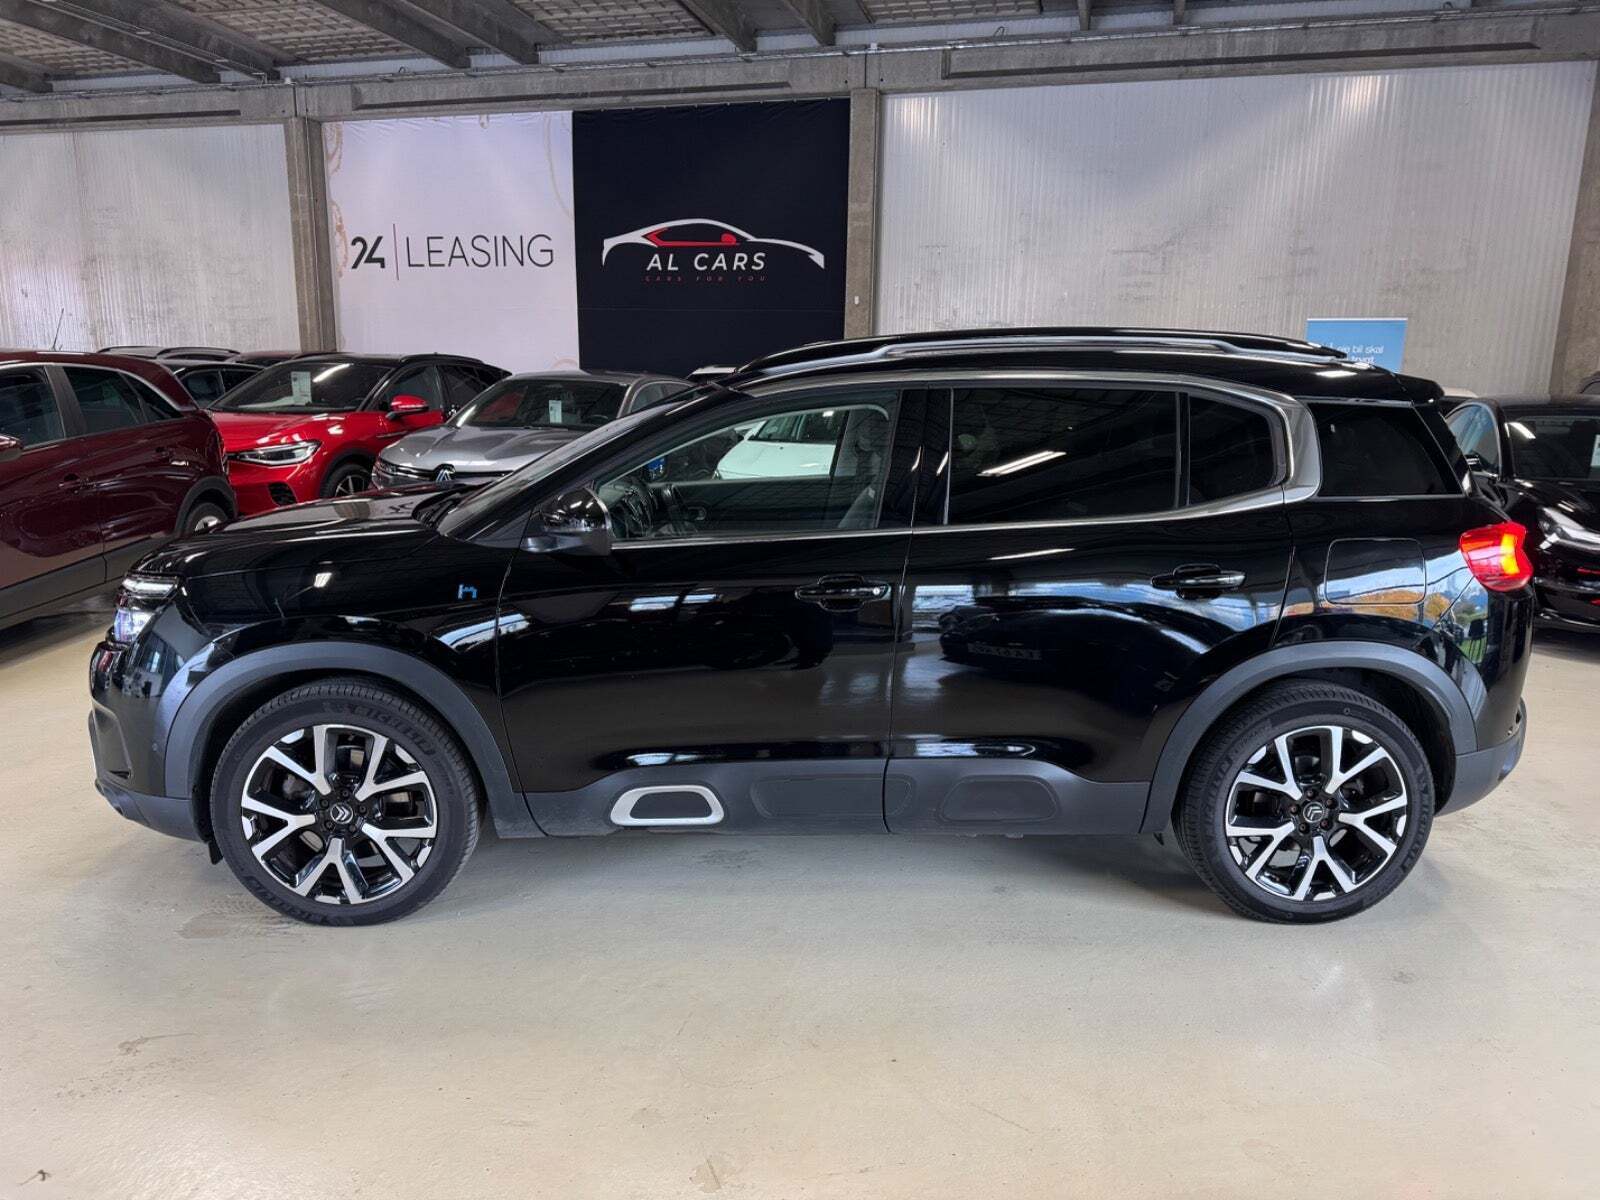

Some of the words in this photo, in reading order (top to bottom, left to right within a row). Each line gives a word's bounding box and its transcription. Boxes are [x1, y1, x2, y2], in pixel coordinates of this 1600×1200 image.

[351, 236, 386, 269] 24
[406, 234, 554, 268] LEASING
[646, 253, 679, 271] AL
[694, 252, 766, 271] CARS
